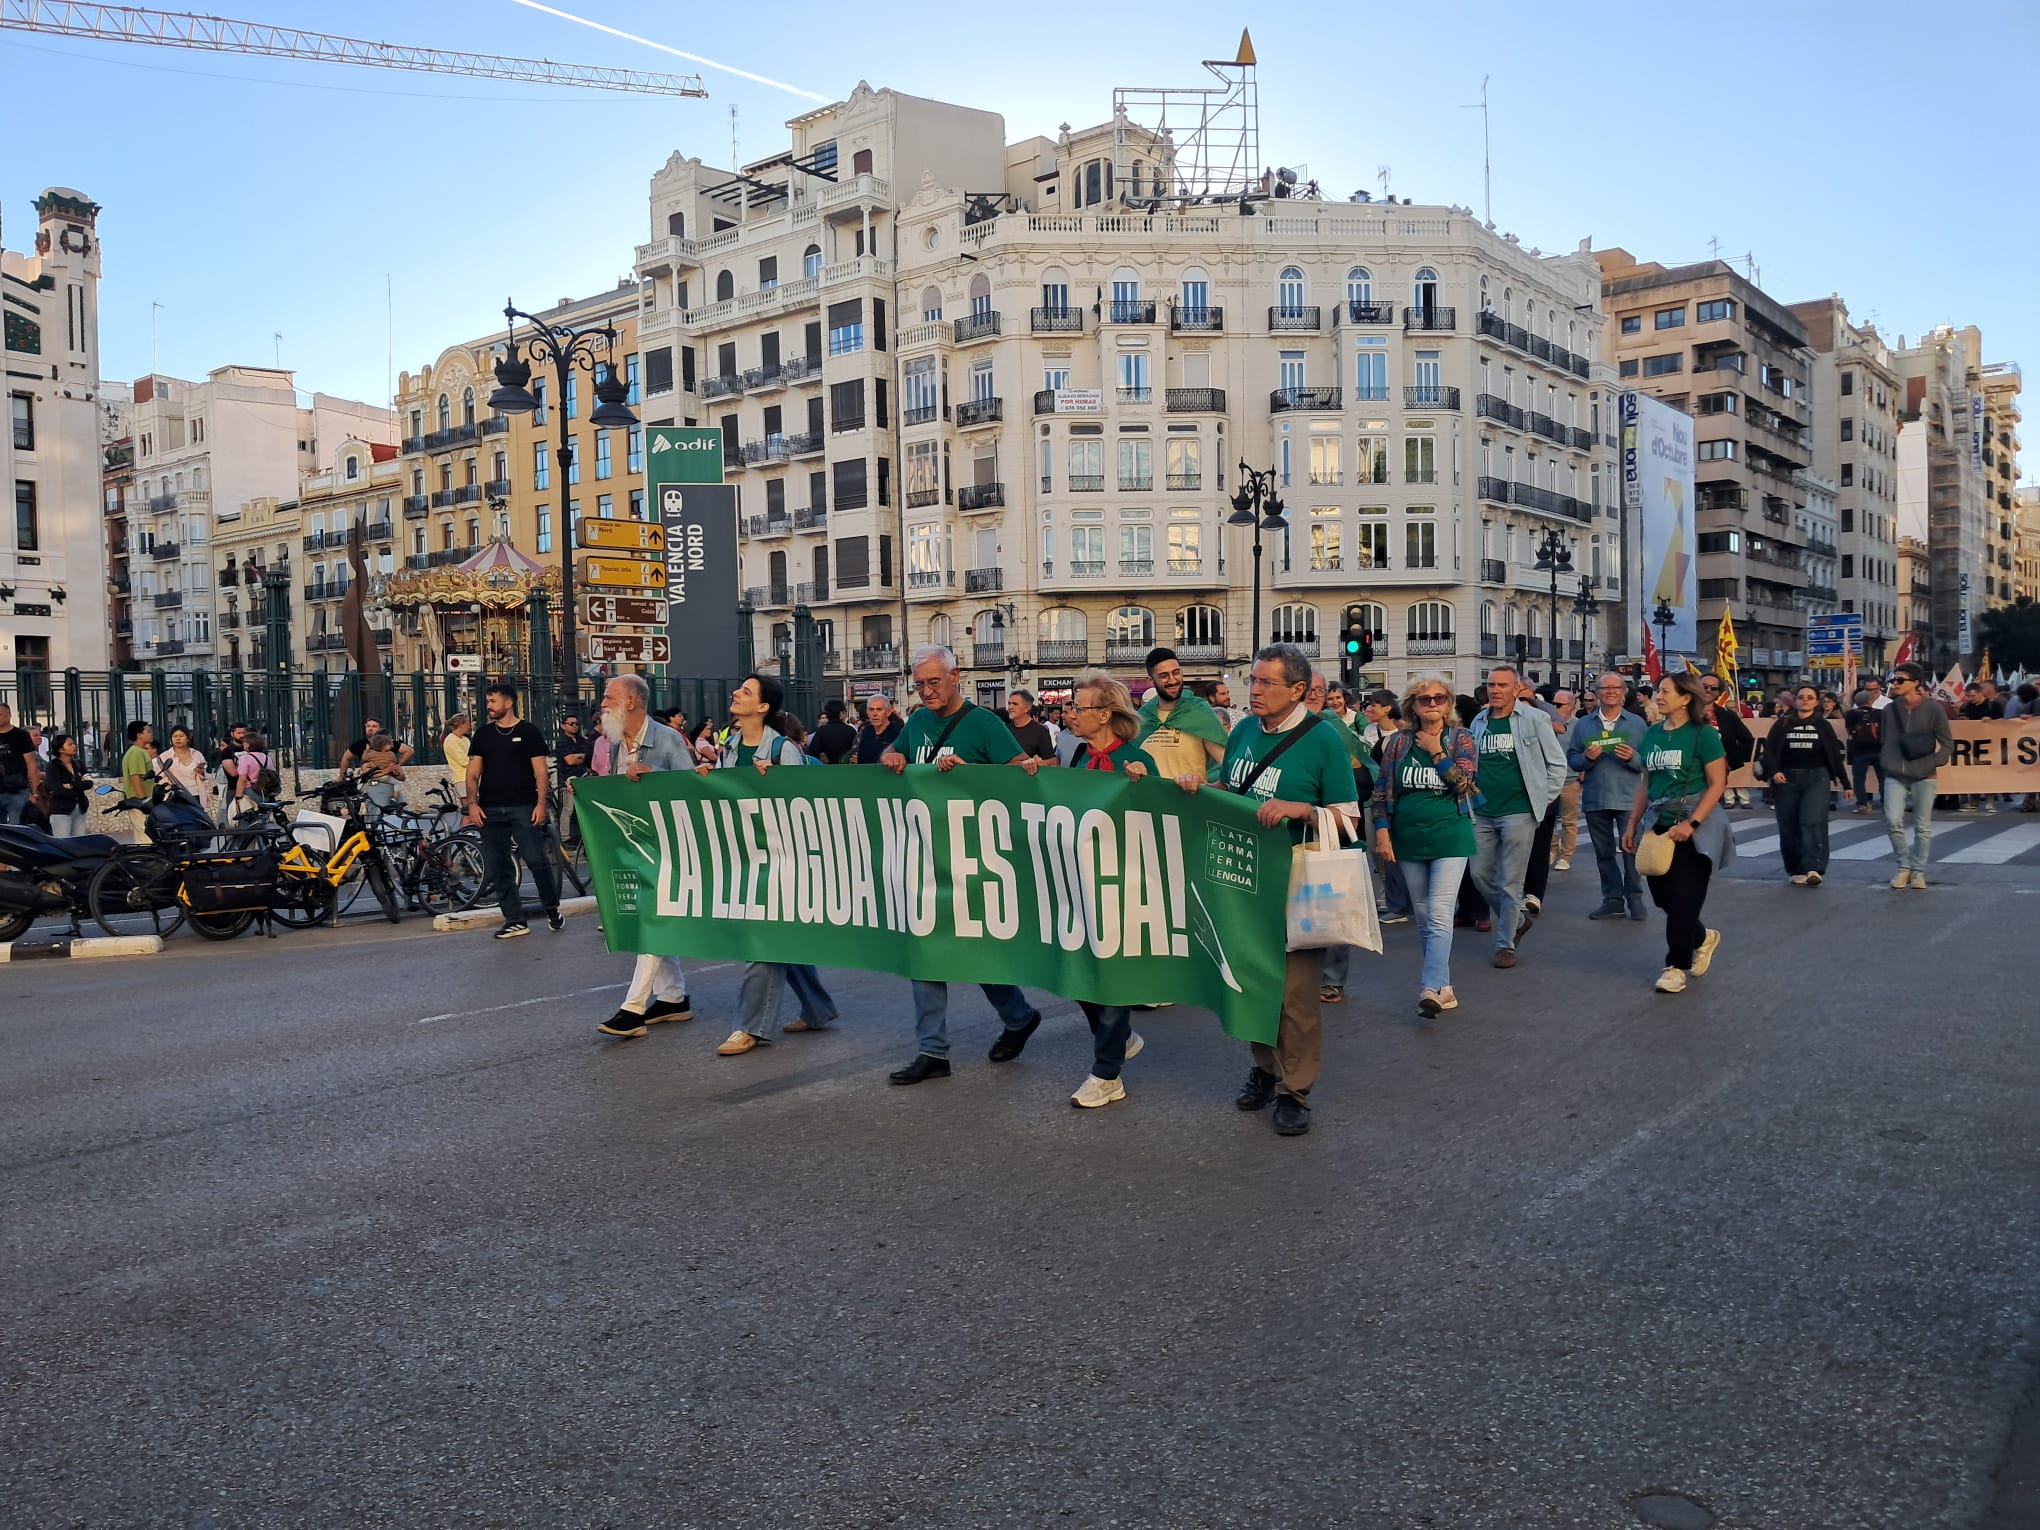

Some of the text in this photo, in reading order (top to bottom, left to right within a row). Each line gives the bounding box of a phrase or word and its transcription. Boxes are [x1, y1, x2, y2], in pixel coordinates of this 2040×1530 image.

[1673, 422, 1687, 445] Nou
[674, 438, 717, 451] adif
[687, 523, 705, 571] NORD
[666, 524, 686, 606] VALENCIA
[1950, 736, 2040, 766] RE I S
[1230, 758, 1245, 783] LA
[1402, 766, 1413, 784] LA
[1253, 788, 1274, 798] TOCA
[1212, 826, 1254, 846] PLATA
[1211, 839, 1254, 860] FORMA
[1209, 852, 1252, 873] PER LA
[649, 796, 1190, 959] LA LLENGUA NO ES TOCA!
[1208, 866, 1252, 887] LLENGUA
